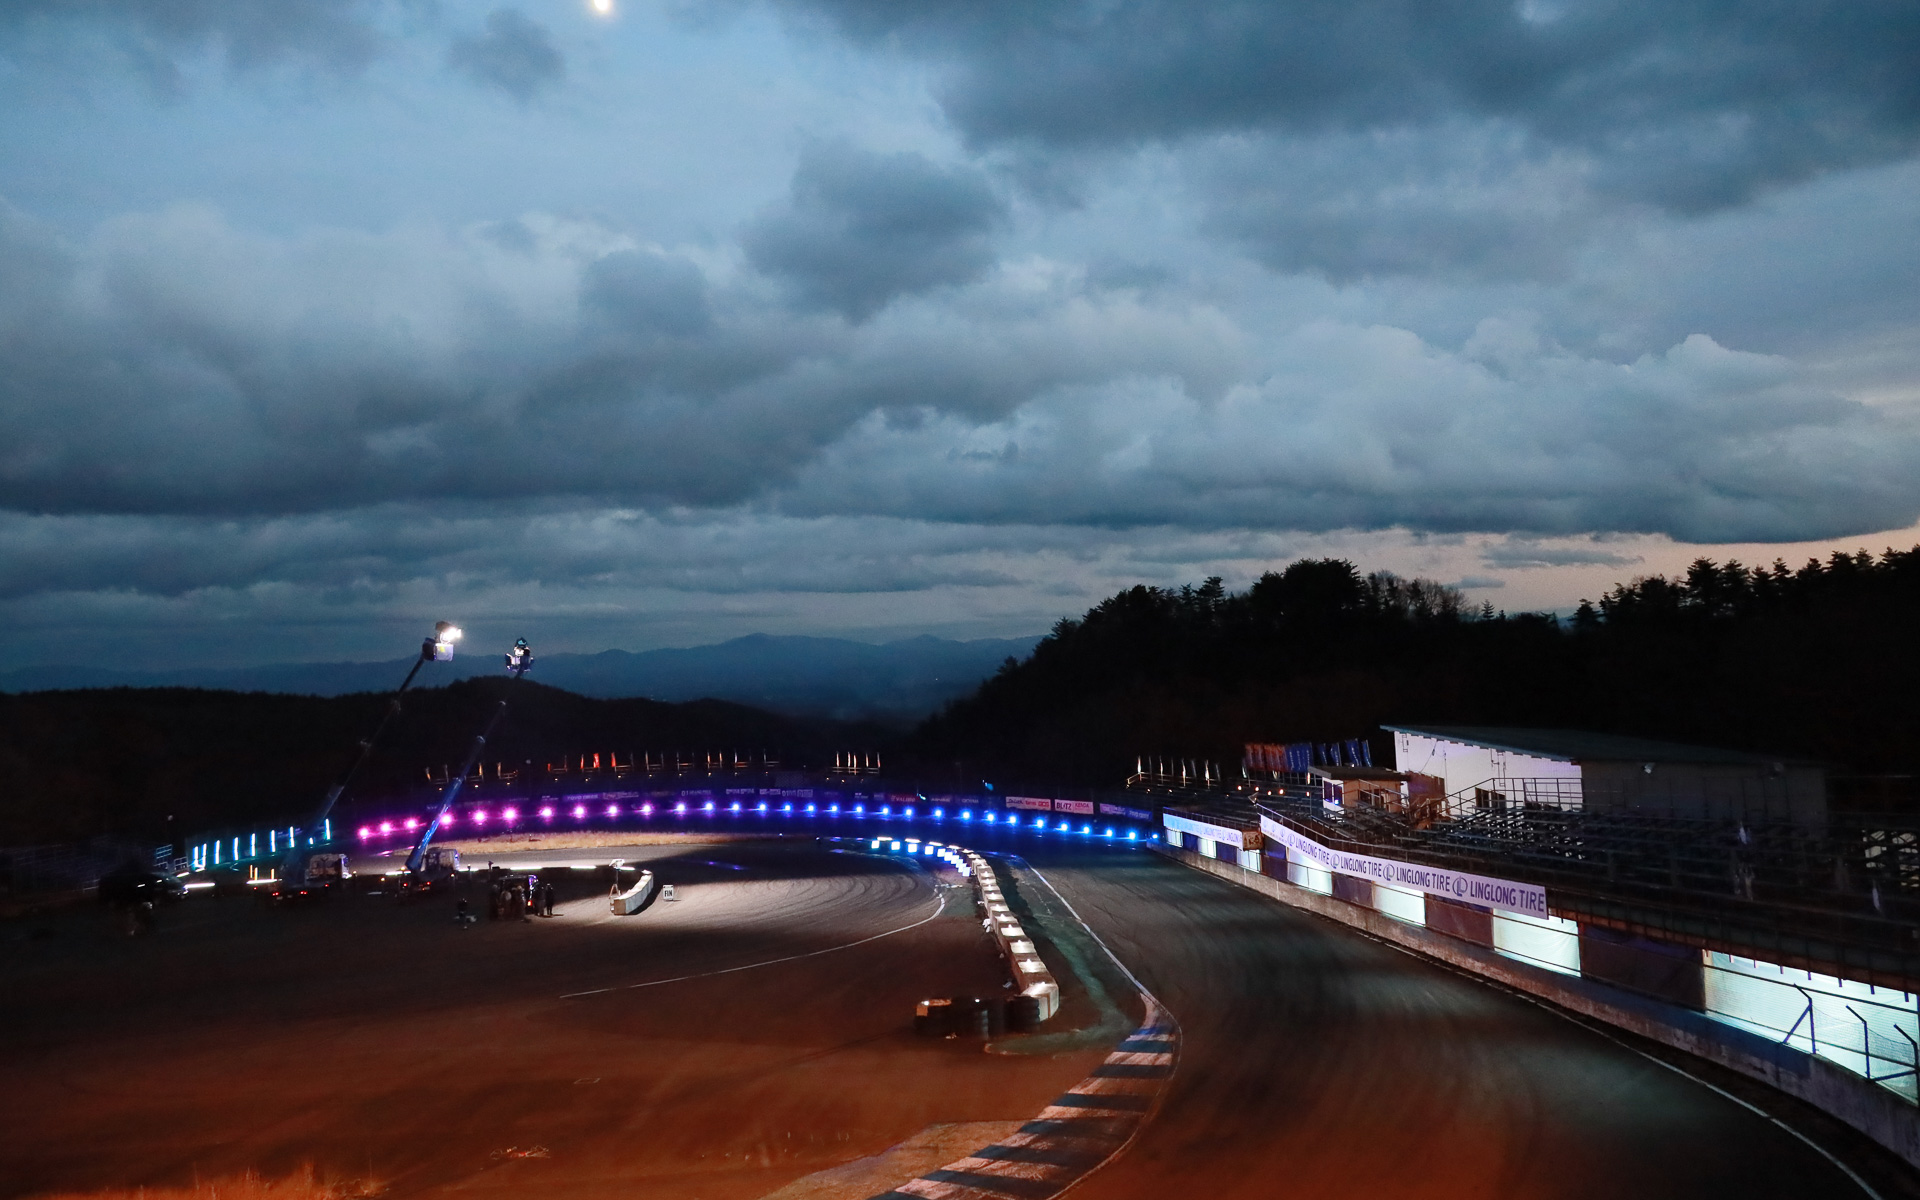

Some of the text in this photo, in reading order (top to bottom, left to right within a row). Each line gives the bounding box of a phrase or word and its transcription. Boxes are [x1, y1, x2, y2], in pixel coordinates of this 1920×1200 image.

[1056, 802, 1072, 810] BLITZ
[1295, 838, 1330, 865] LINGLONG TIRE
[1340, 856, 1382, 877] LINGLONG TIRE
[1396, 866, 1451, 892] LINGLONG TIRE
[1470, 881, 1545, 912] LINGLONG TIRE
